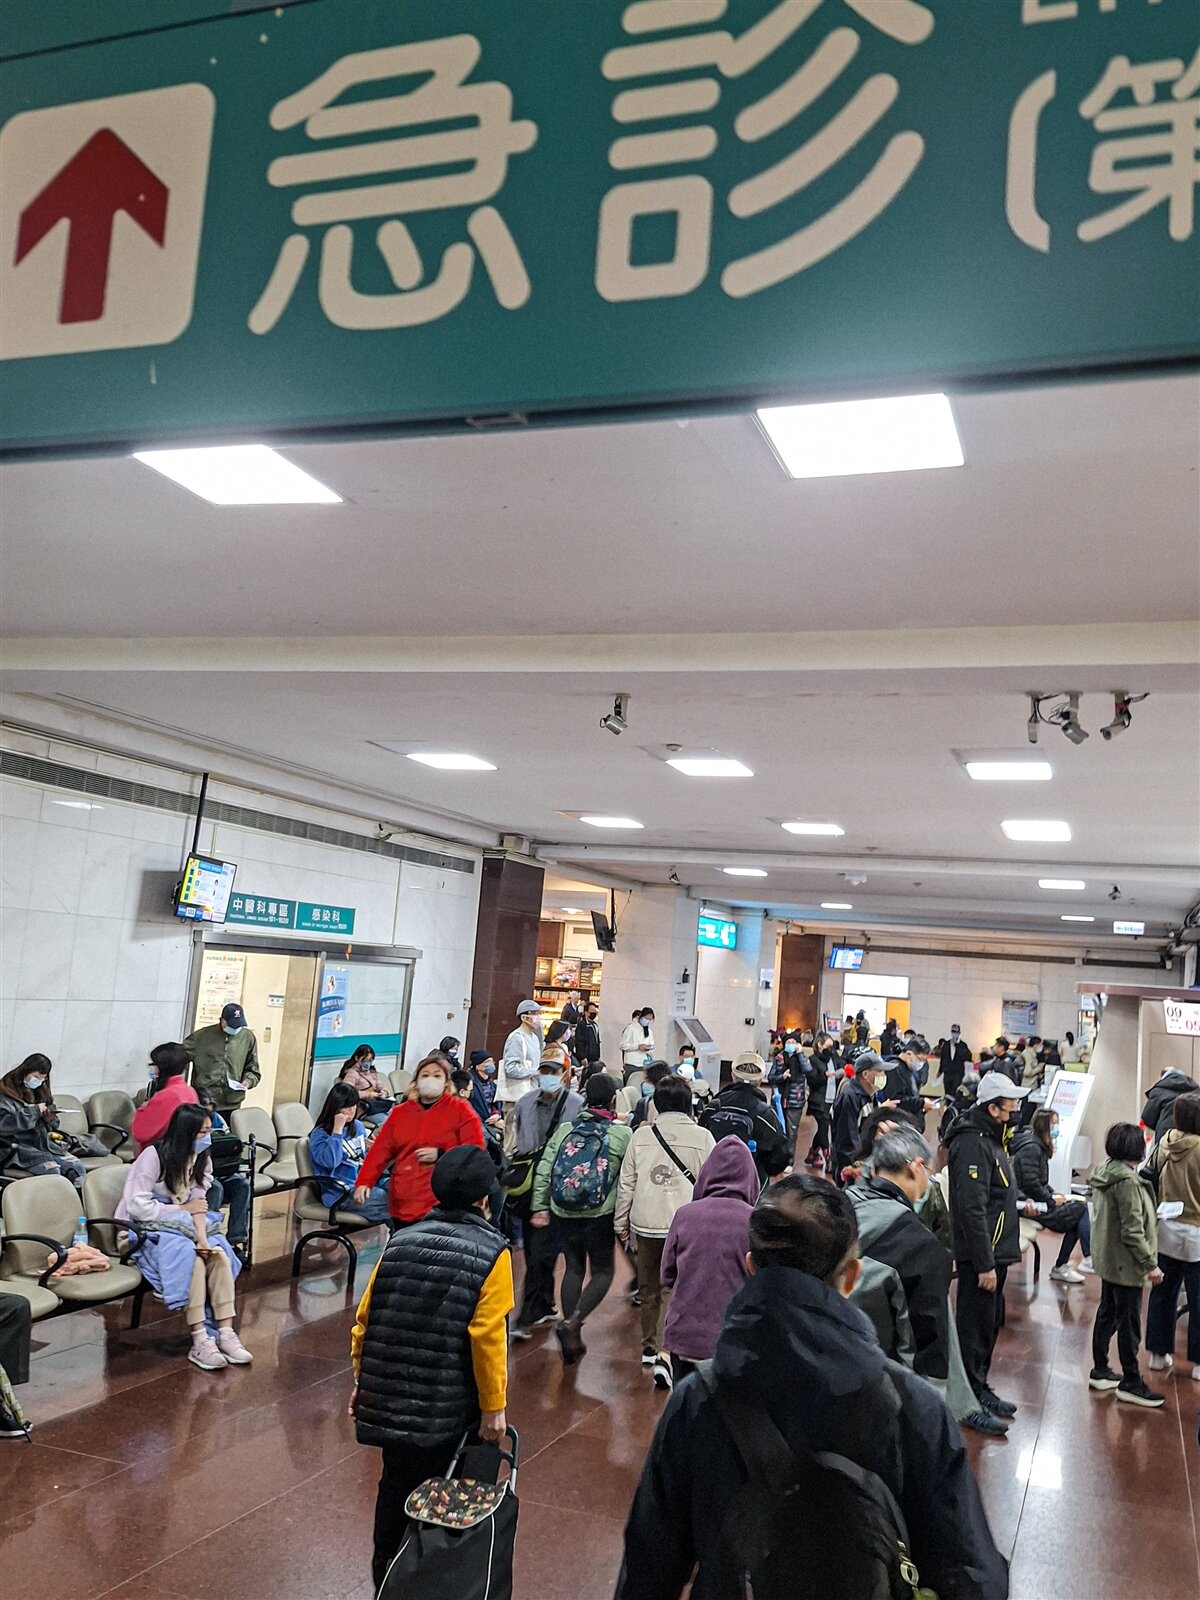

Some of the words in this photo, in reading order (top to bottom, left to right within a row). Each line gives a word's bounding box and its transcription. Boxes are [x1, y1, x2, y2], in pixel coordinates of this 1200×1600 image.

[249, 0, 935, 336] 急診
[232, 897, 289, 917] 中醫科專區
[311, 907, 341, 923] 感染科
